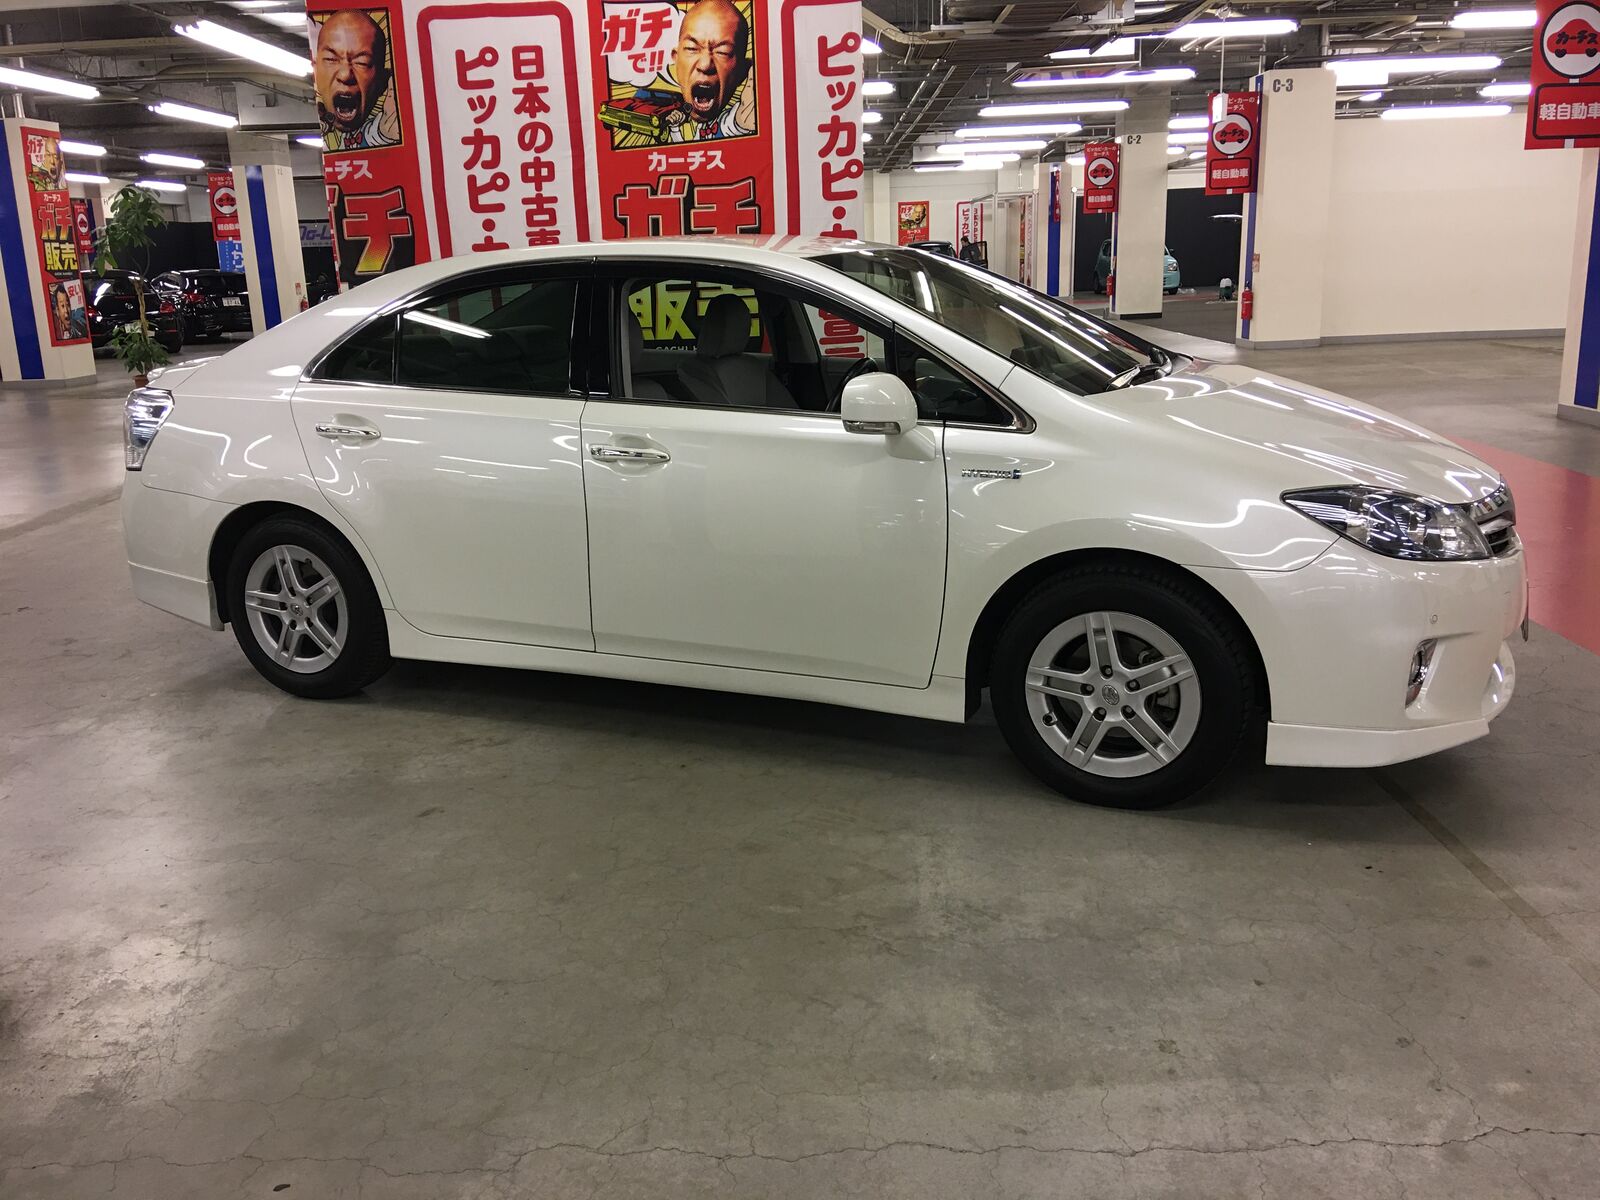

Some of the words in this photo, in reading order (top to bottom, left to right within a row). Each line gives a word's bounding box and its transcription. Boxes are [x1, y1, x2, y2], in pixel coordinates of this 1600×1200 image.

[600, 7, 673, 54] ガチ
[1555, 30, 1599, 45] カーチス
[1272, 78, 1294, 92] C-3
[1539, 102, 1600, 121] 軽自動車
[1127, 134, 1142, 145] C-2
[648, 150, 726, 172] カーチス
[38, 203, 72, 240] ガチ
[44, 242, 79, 271] 販売
